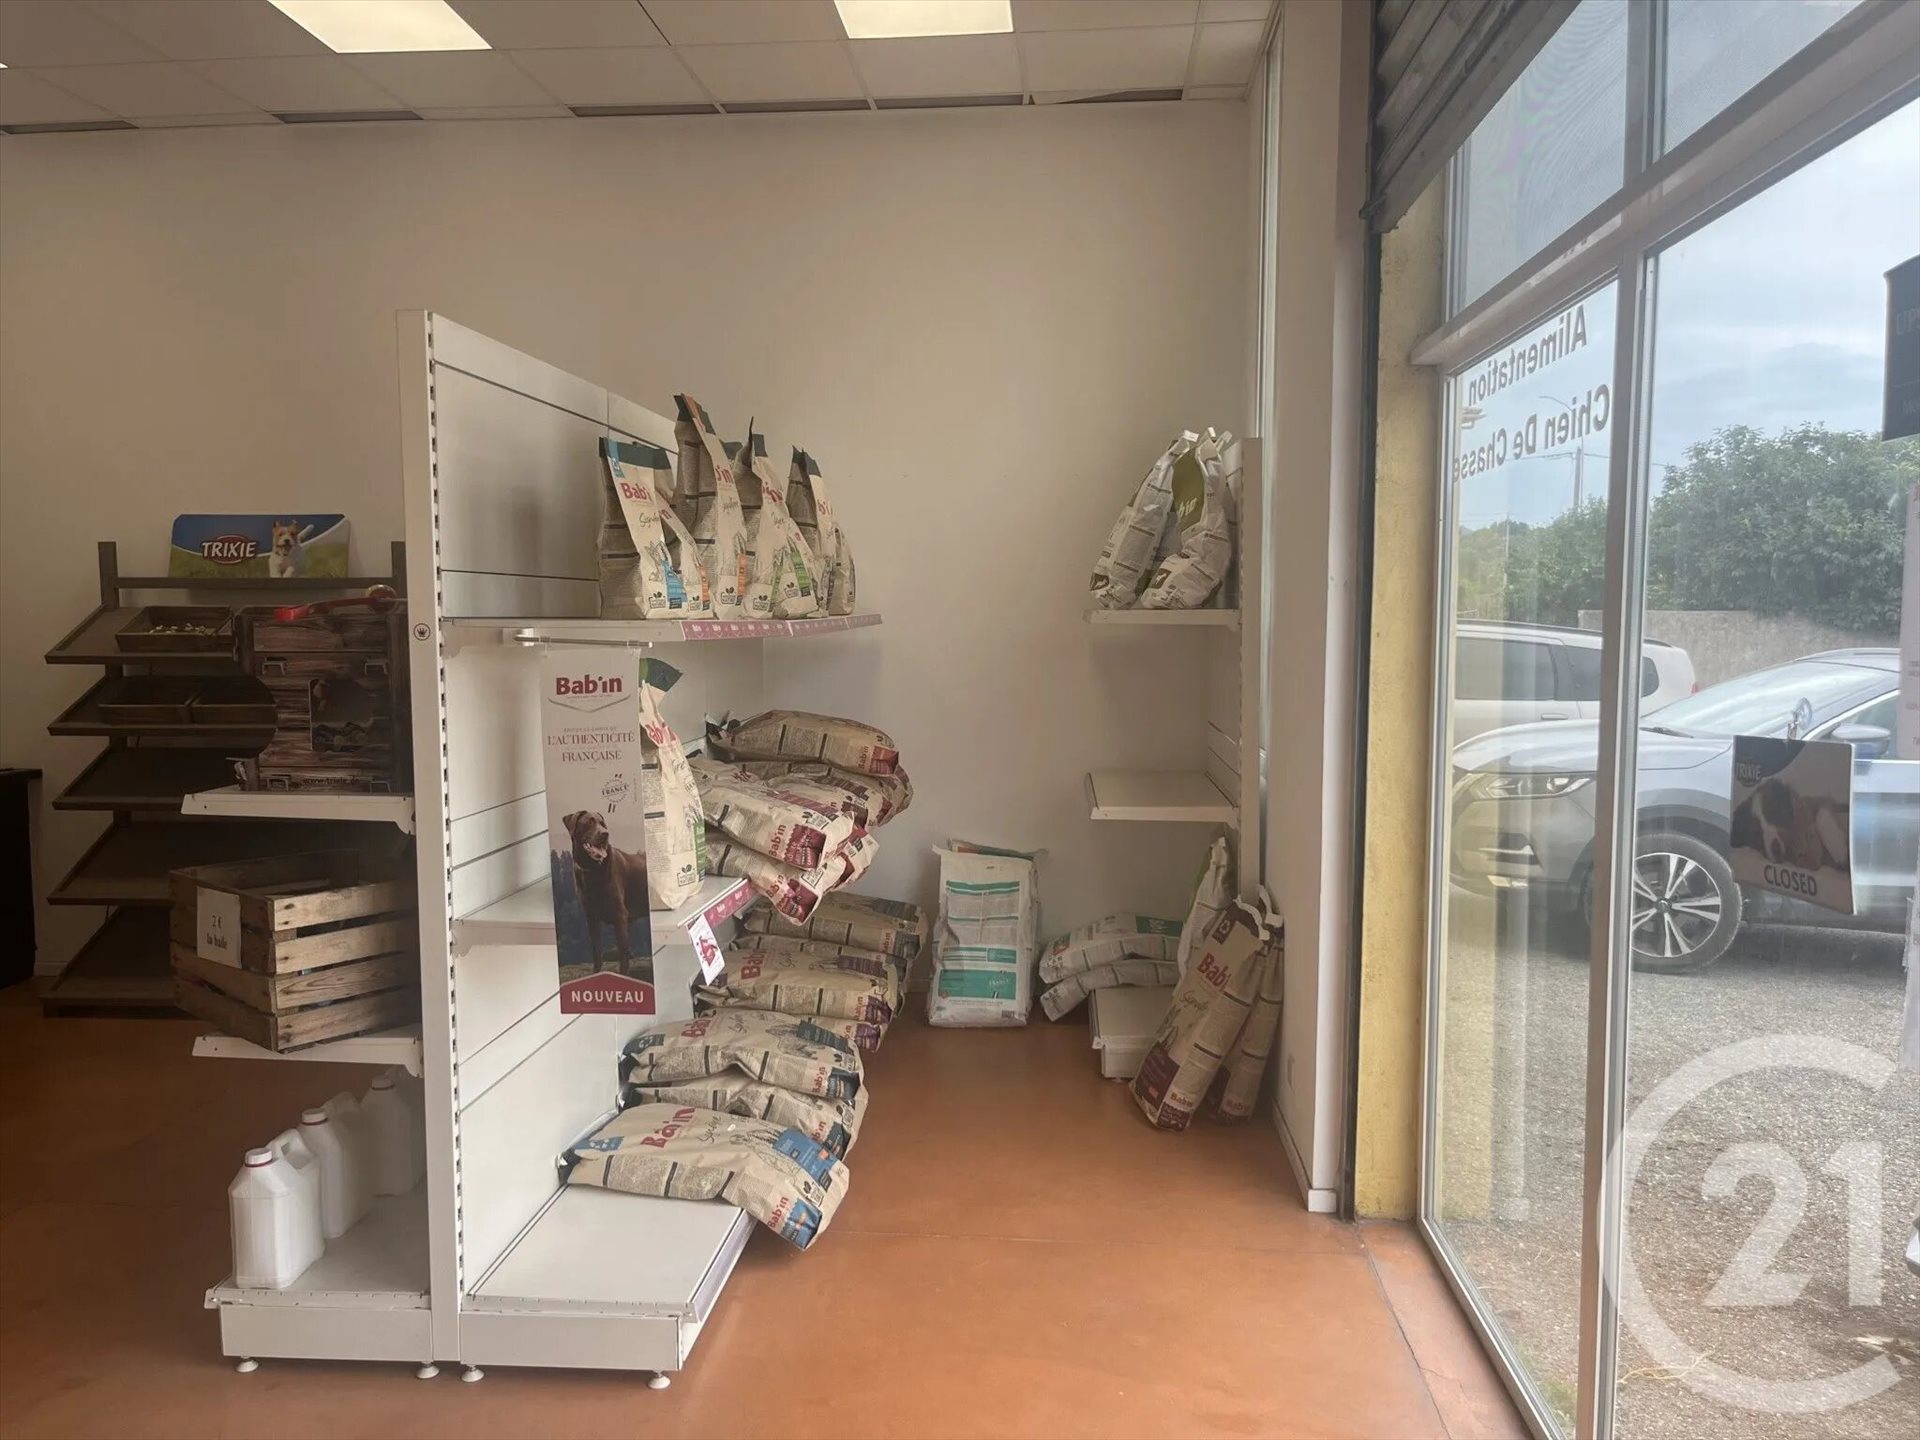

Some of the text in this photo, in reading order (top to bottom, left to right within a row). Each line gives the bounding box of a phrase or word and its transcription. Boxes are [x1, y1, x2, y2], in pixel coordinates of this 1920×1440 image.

[201, 540, 257, 560] TRIXIE
[556, 674, 623, 695] Bab'in
[547, 730, 635, 746] L'AUTHENTICITÉ
[562, 750, 622, 763] FRANÇAISE
[1764, 865, 1817, 896] CLOSED
[571, 989, 644, 1004] NOUVEAU
[768, 1196, 789, 1229] Bab'in
